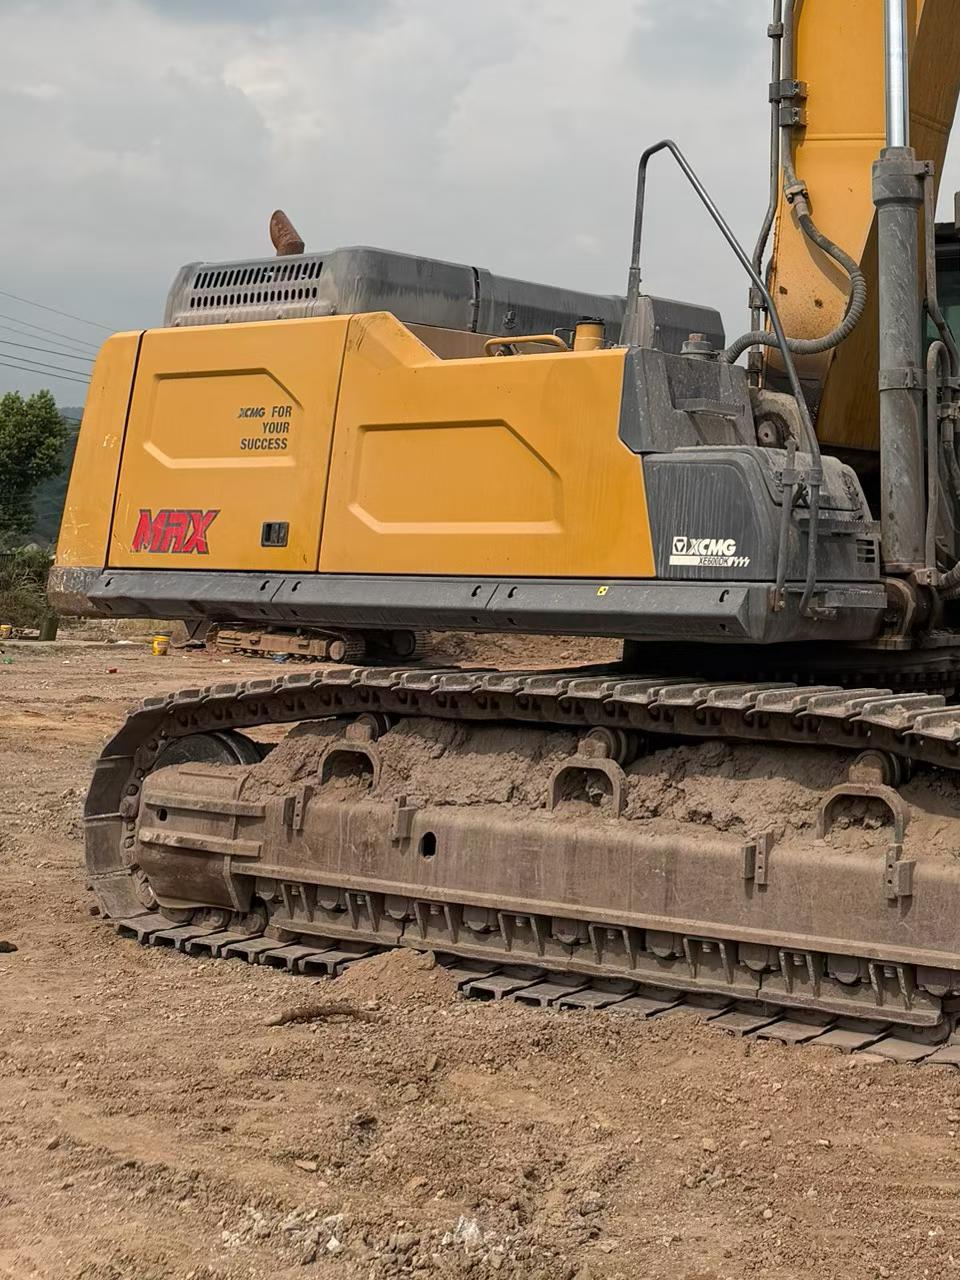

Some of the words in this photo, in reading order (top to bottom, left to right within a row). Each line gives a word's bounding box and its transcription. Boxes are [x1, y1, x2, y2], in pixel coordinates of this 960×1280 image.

[238, 407, 265, 418] XCMG
[271, 405, 292, 418] FOR
[262, 421, 290, 434] YOUR
[240, 437, 288, 450] SUCCESS
[130, 509, 221, 554] MAX
[687, 538, 737, 556] XCMG
